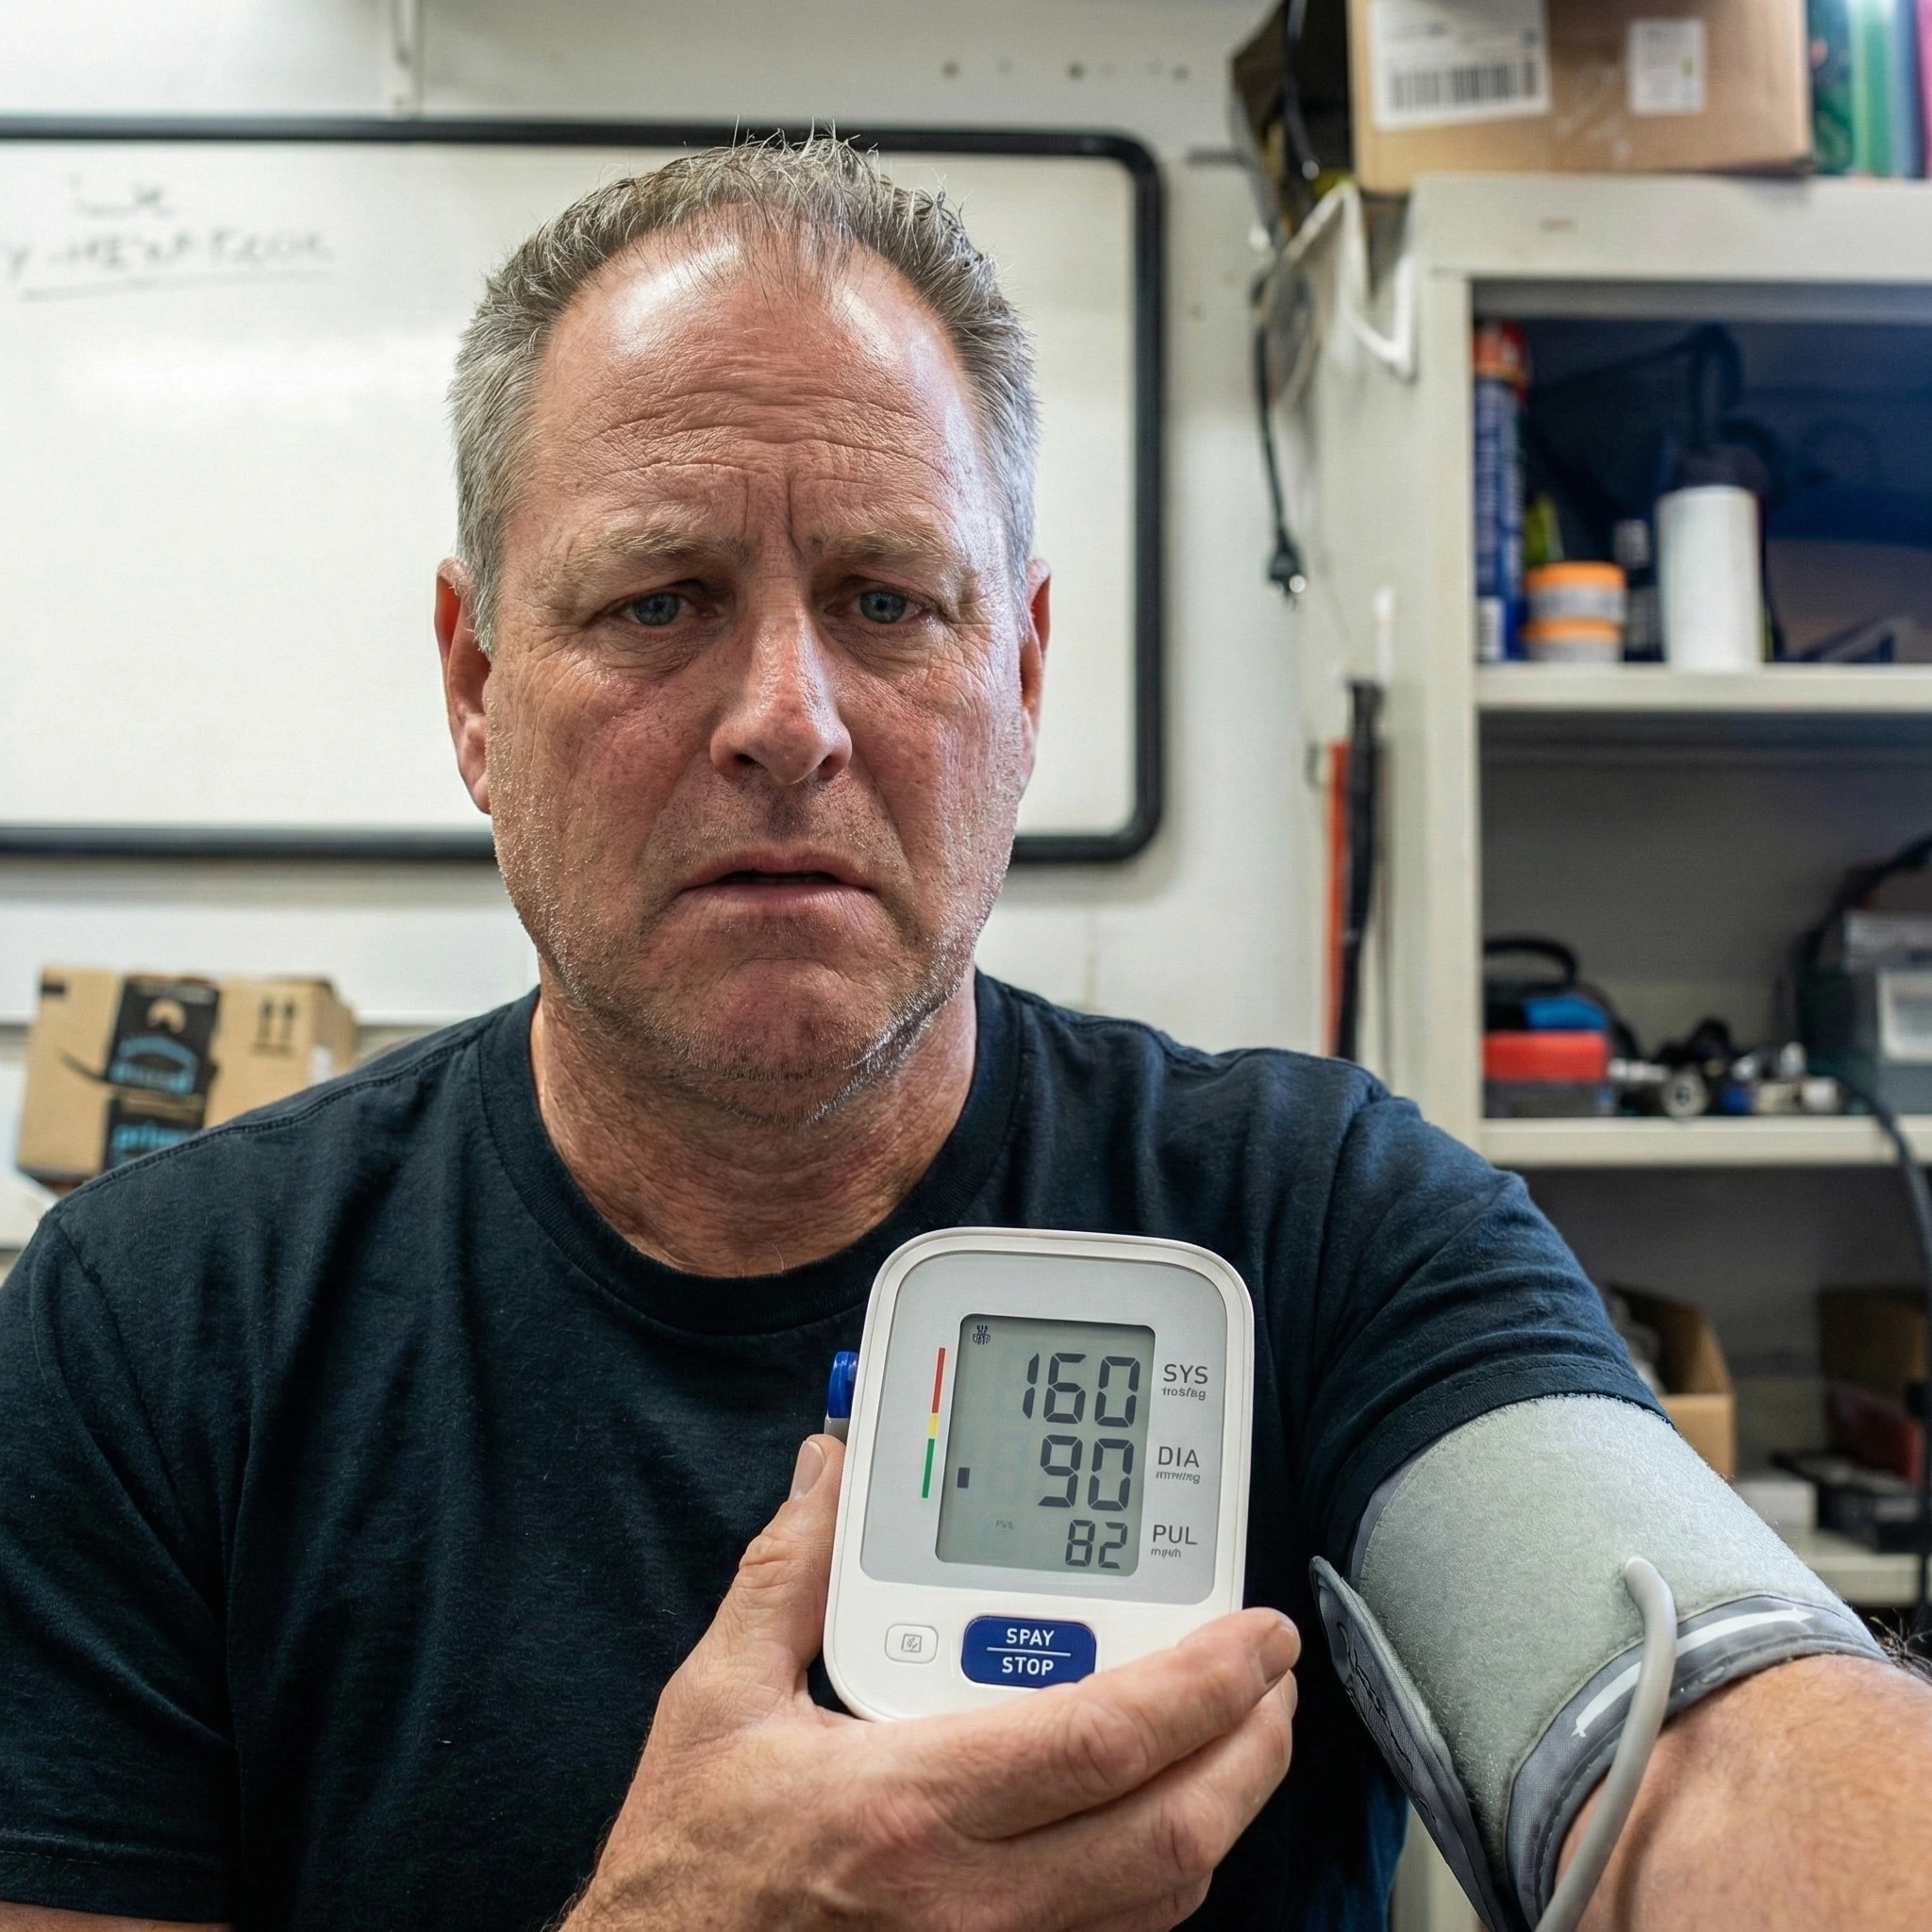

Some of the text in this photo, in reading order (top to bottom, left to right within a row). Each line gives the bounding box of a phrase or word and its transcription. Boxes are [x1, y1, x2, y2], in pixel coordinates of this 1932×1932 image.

[1163, 1363, 1208, 1385] SYS
[1022, 1352, 1141, 1428] 160
[1158, 1445, 1200, 1468] DIA
[1038, 1434, 1135, 1511] 90
[1065, 1519, 1128, 1570] 82
[1152, 1524, 1198, 1545] PUL
[1006, 1627, 1055, 1647] SPAY
[1002, 1657, 1055, 1676] STOP
